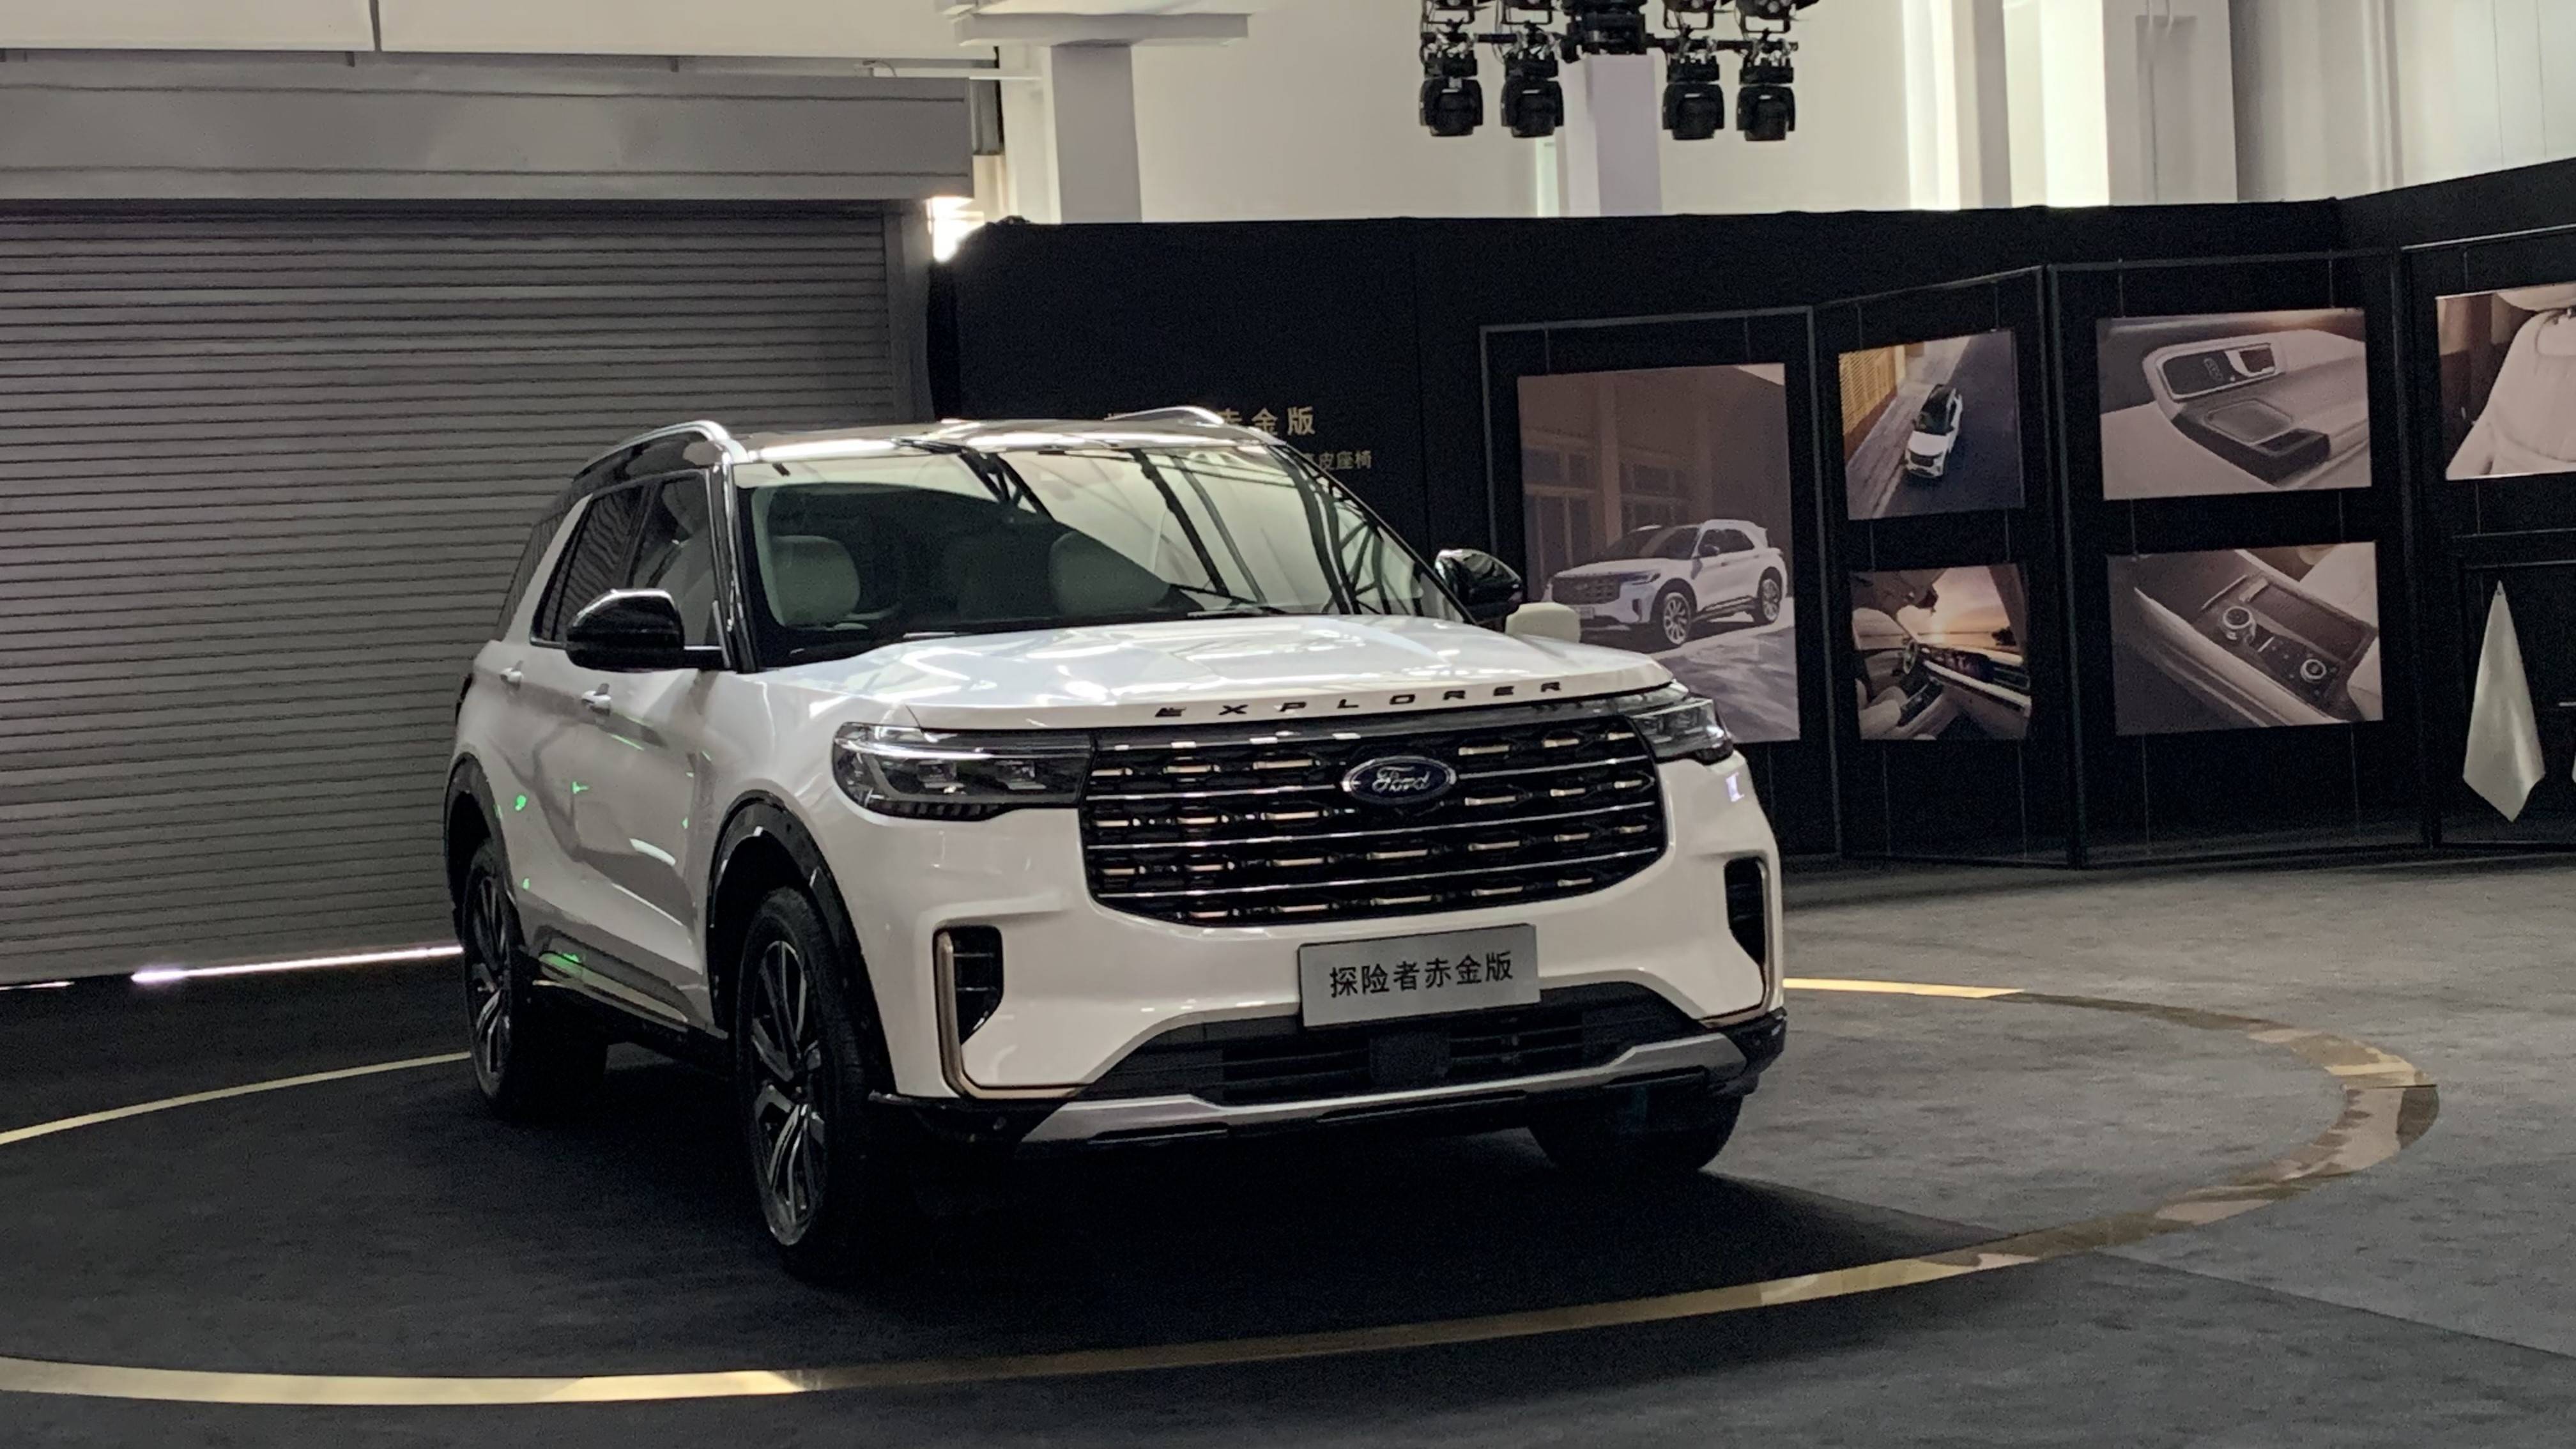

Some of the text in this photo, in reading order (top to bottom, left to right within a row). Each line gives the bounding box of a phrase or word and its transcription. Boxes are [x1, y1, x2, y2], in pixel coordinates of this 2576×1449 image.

[1154, 681, 1562, 717] EXPLORER
[1372, 766, 1430, 793] Ford
[1330, 950, 1514, 998] 探险者赤金版
